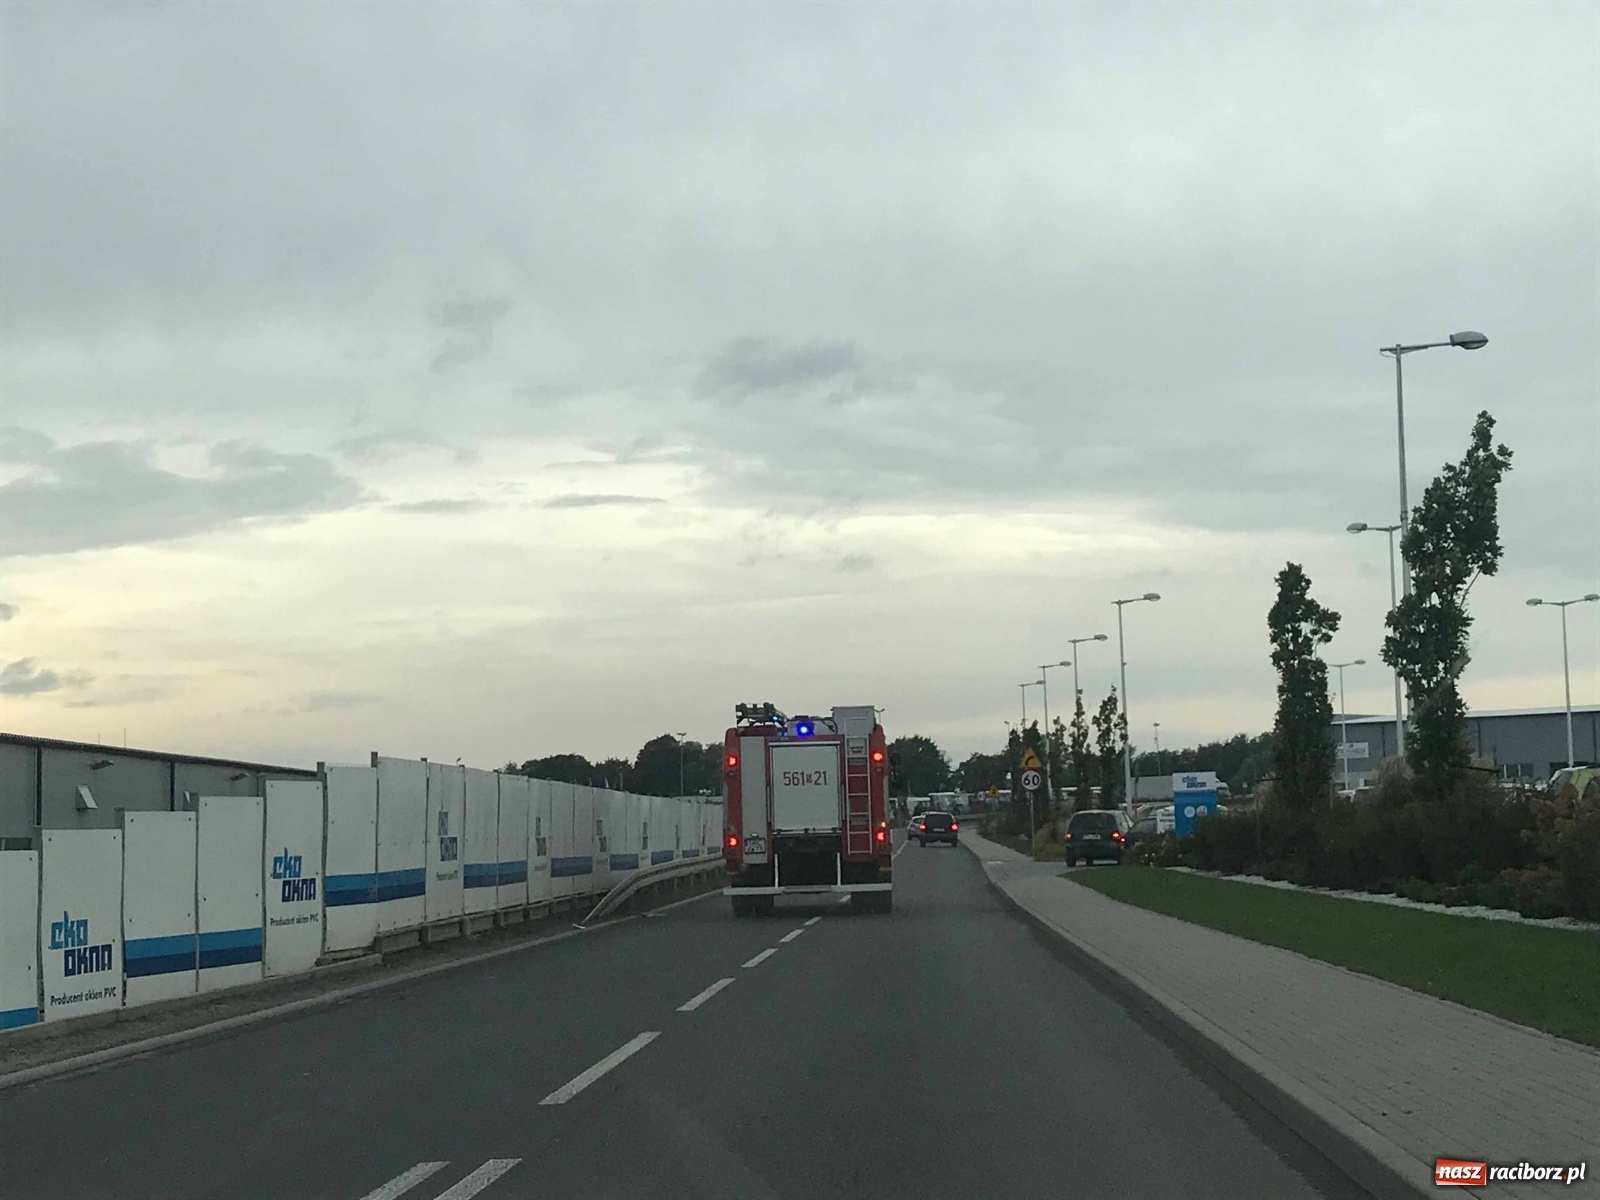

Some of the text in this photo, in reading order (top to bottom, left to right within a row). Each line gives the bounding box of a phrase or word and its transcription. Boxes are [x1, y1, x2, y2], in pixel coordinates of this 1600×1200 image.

[783, 771, 805, 786] 561
[813, 770, 827, 786] 21
[1023, 774, 1040, 786] 60
[50, 992, 83, 1006] Producent
[104, 986, 117, 998] PVC
